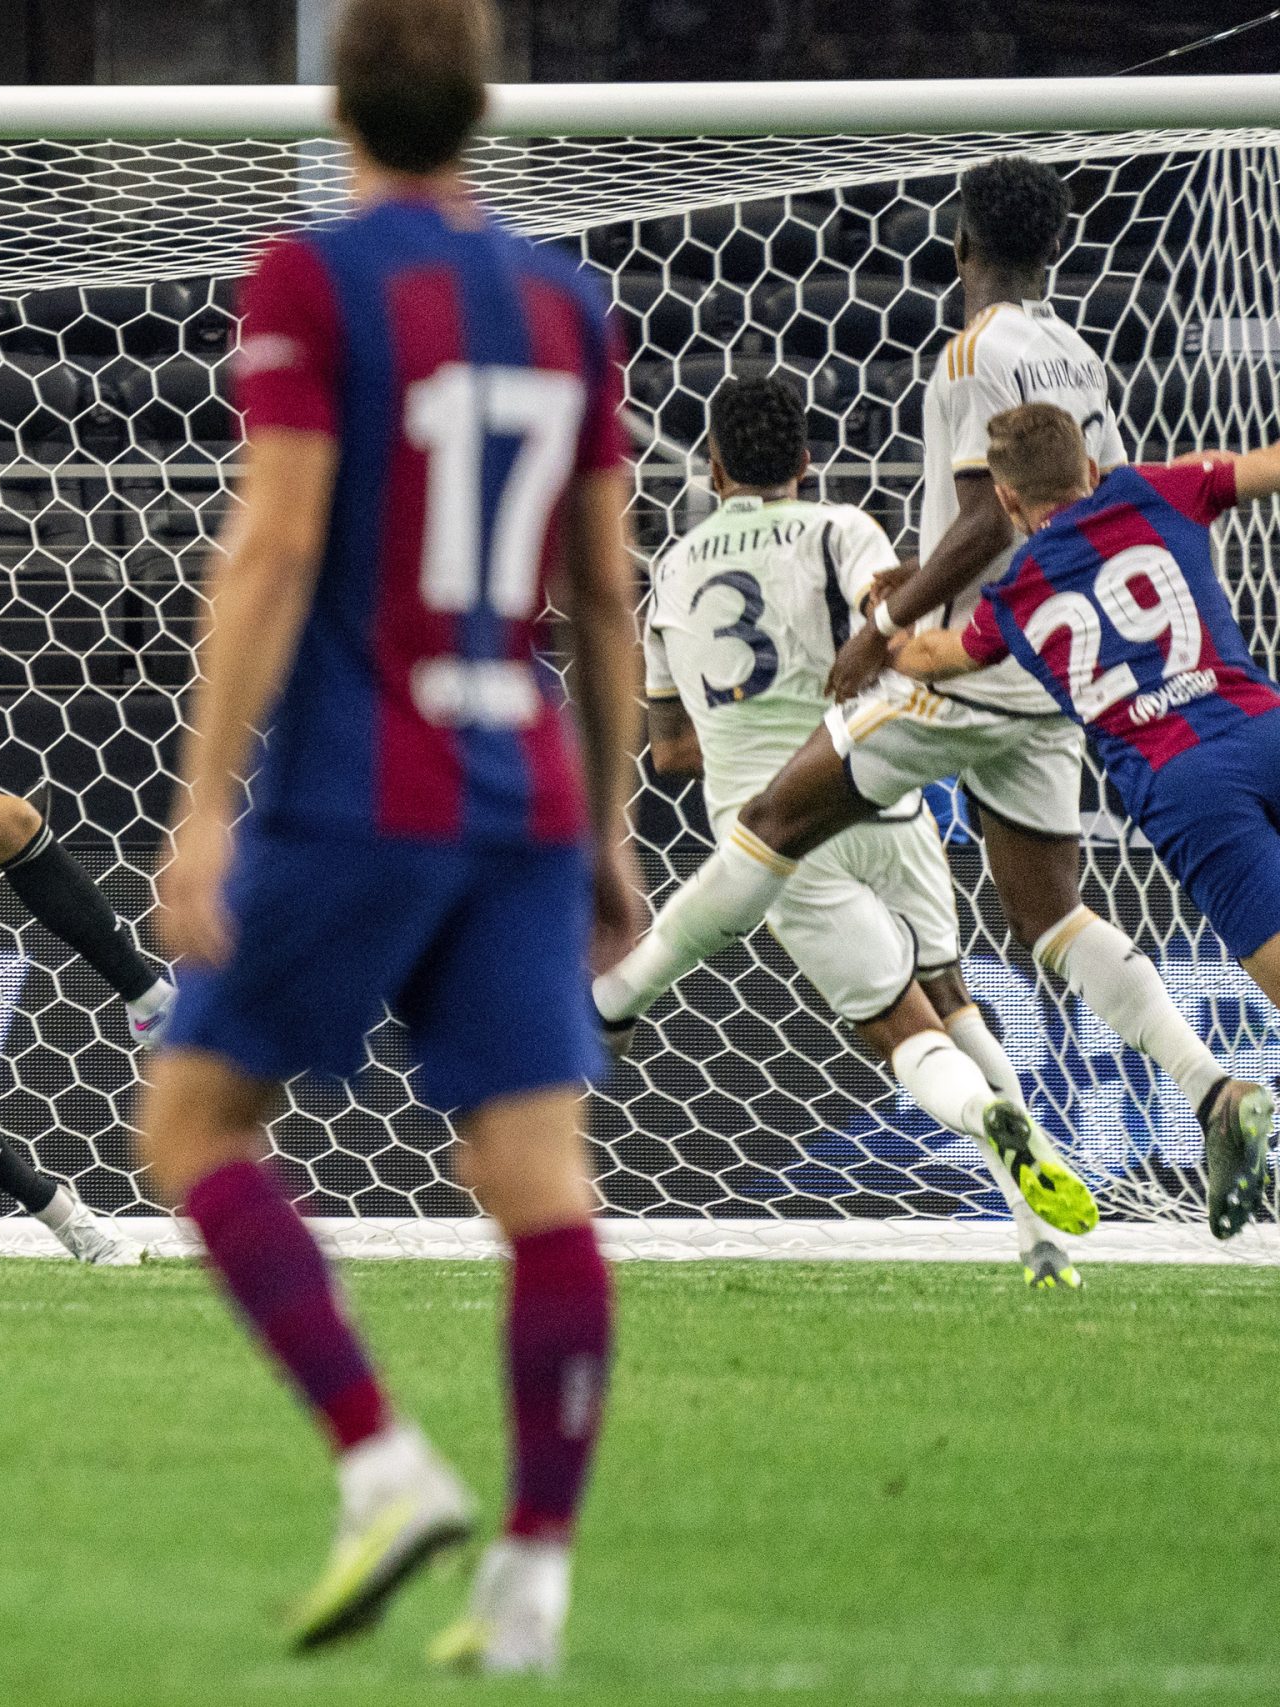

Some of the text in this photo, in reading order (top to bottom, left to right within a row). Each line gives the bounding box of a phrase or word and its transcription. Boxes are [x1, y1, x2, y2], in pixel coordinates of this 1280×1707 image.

[403, 360, 588, 620] 17
[687, 518, 806, 567] MILITÃO
[688, 569, 779, 709] 3
[1023, 544, 1202, 724] 29
